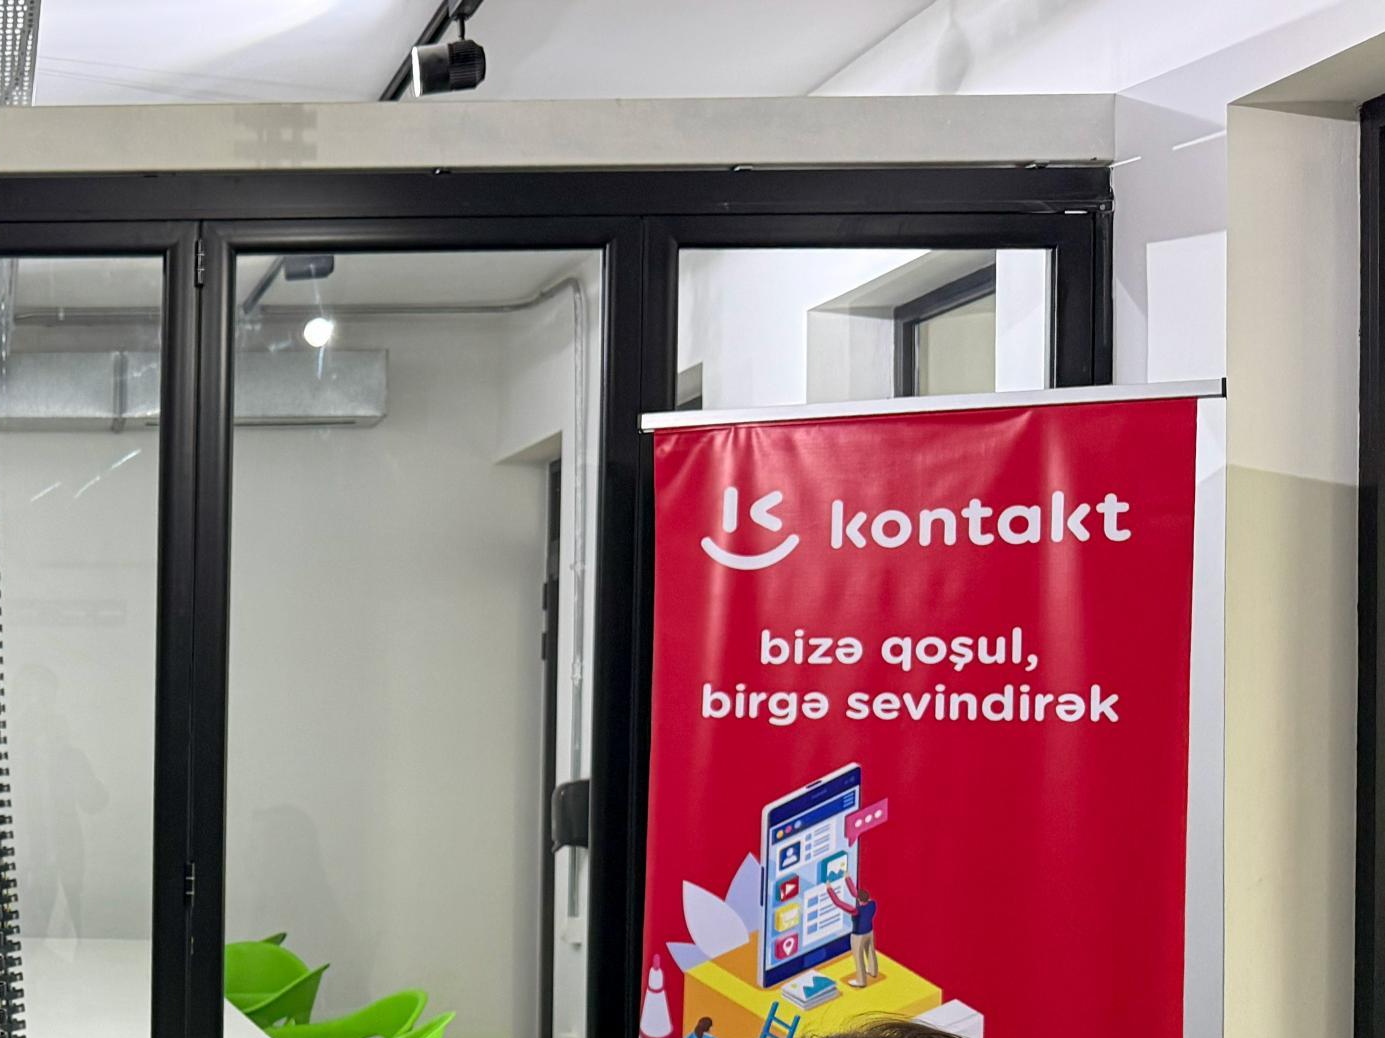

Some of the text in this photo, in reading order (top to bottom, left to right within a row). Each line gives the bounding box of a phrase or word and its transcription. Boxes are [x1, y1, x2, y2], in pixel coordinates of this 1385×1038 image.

[830, 490, 1132, 550] kontakt
[760, 627, 1039, 672] bizə qoşul,
[701, 683, 1120, 726] birgə sevindirək
